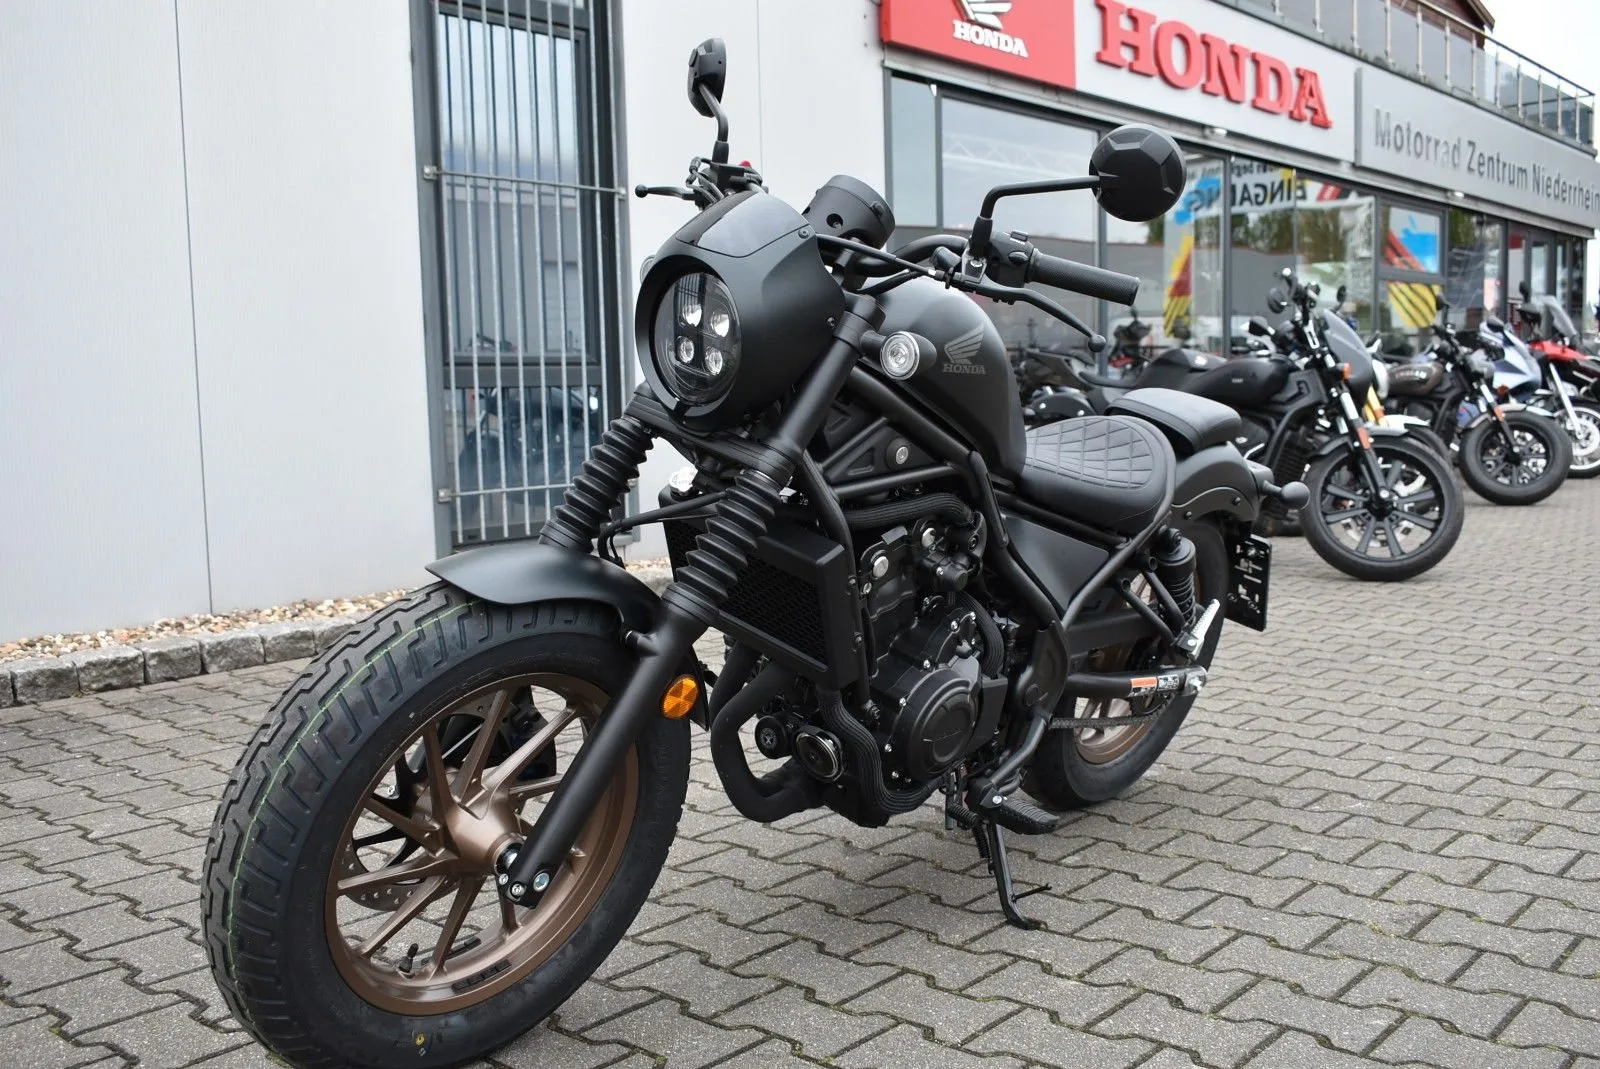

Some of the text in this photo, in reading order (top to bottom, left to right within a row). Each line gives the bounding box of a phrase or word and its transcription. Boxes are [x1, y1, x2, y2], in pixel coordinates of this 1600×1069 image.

[953, 19, 1029, 58] HONDA
[1096, 0, 1332, 129] HONDA
[1374, 108, 1600, 215] Motorrad Zentrum Niederrhein
[943, 363, 987, 375] HONDA
